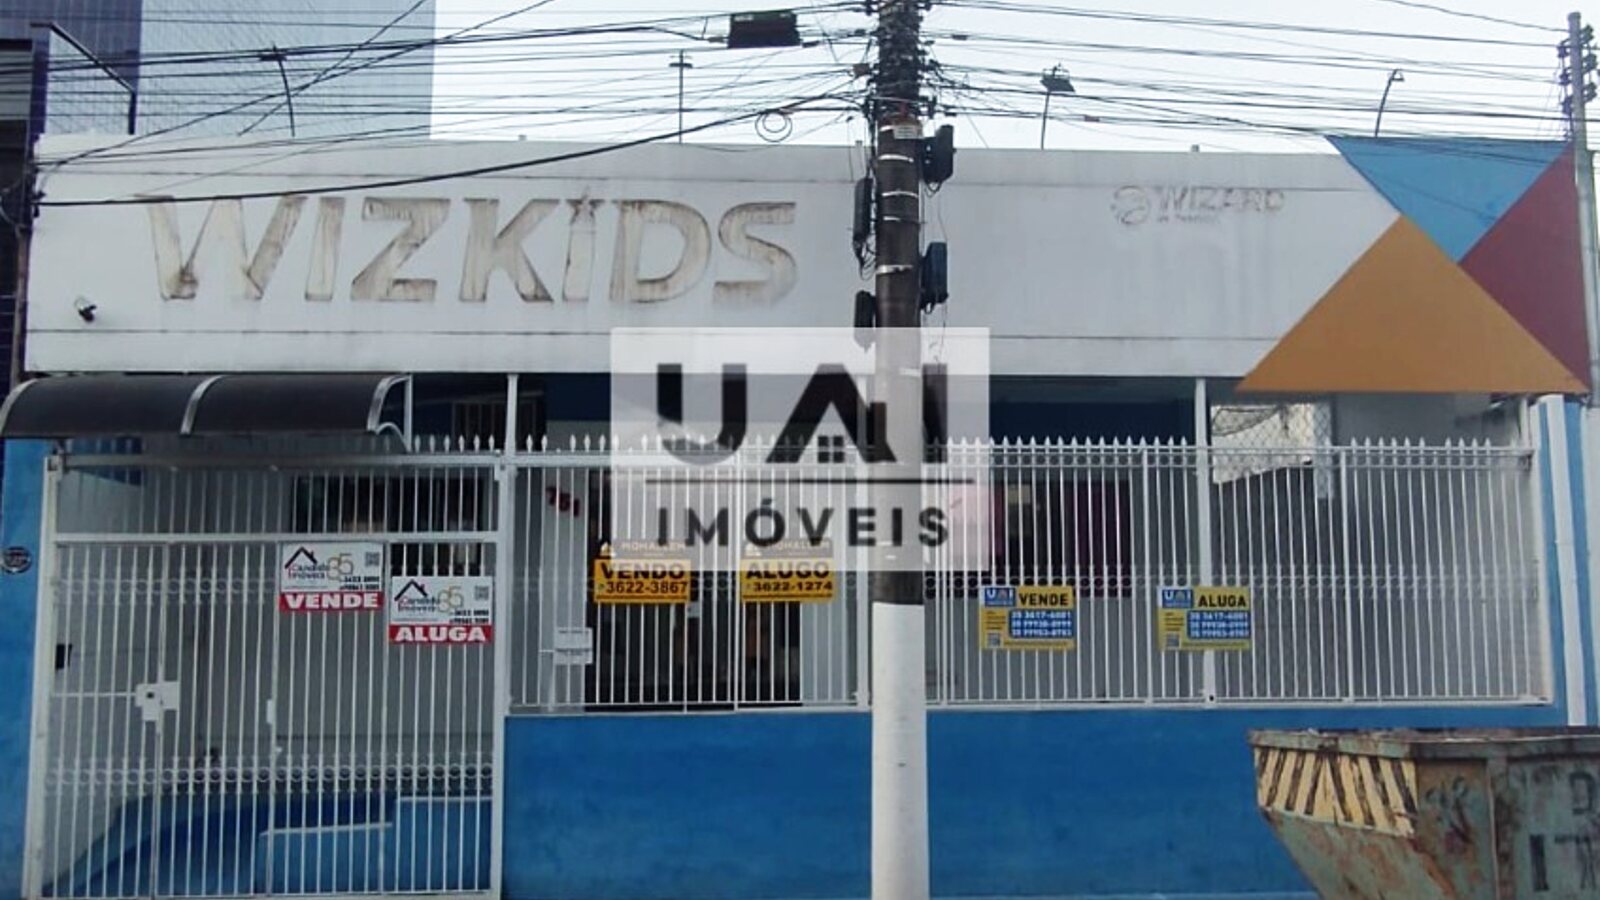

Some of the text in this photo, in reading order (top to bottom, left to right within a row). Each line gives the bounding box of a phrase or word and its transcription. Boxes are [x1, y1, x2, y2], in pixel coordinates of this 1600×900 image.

[600, 562, 687, 580] VENDO
[746, 562, 831, 579] ALUGO
[606, 582, 688, 594] 3622-3867
[752, 582, 833, 592] 3622-1274
[285, 593, 378, 609] VENDE
[1019, 593, 1069, 606] VENDE
[1198, 595, 1247, 608] ALUGA
[394, 626, 486, 642] ALUGA
